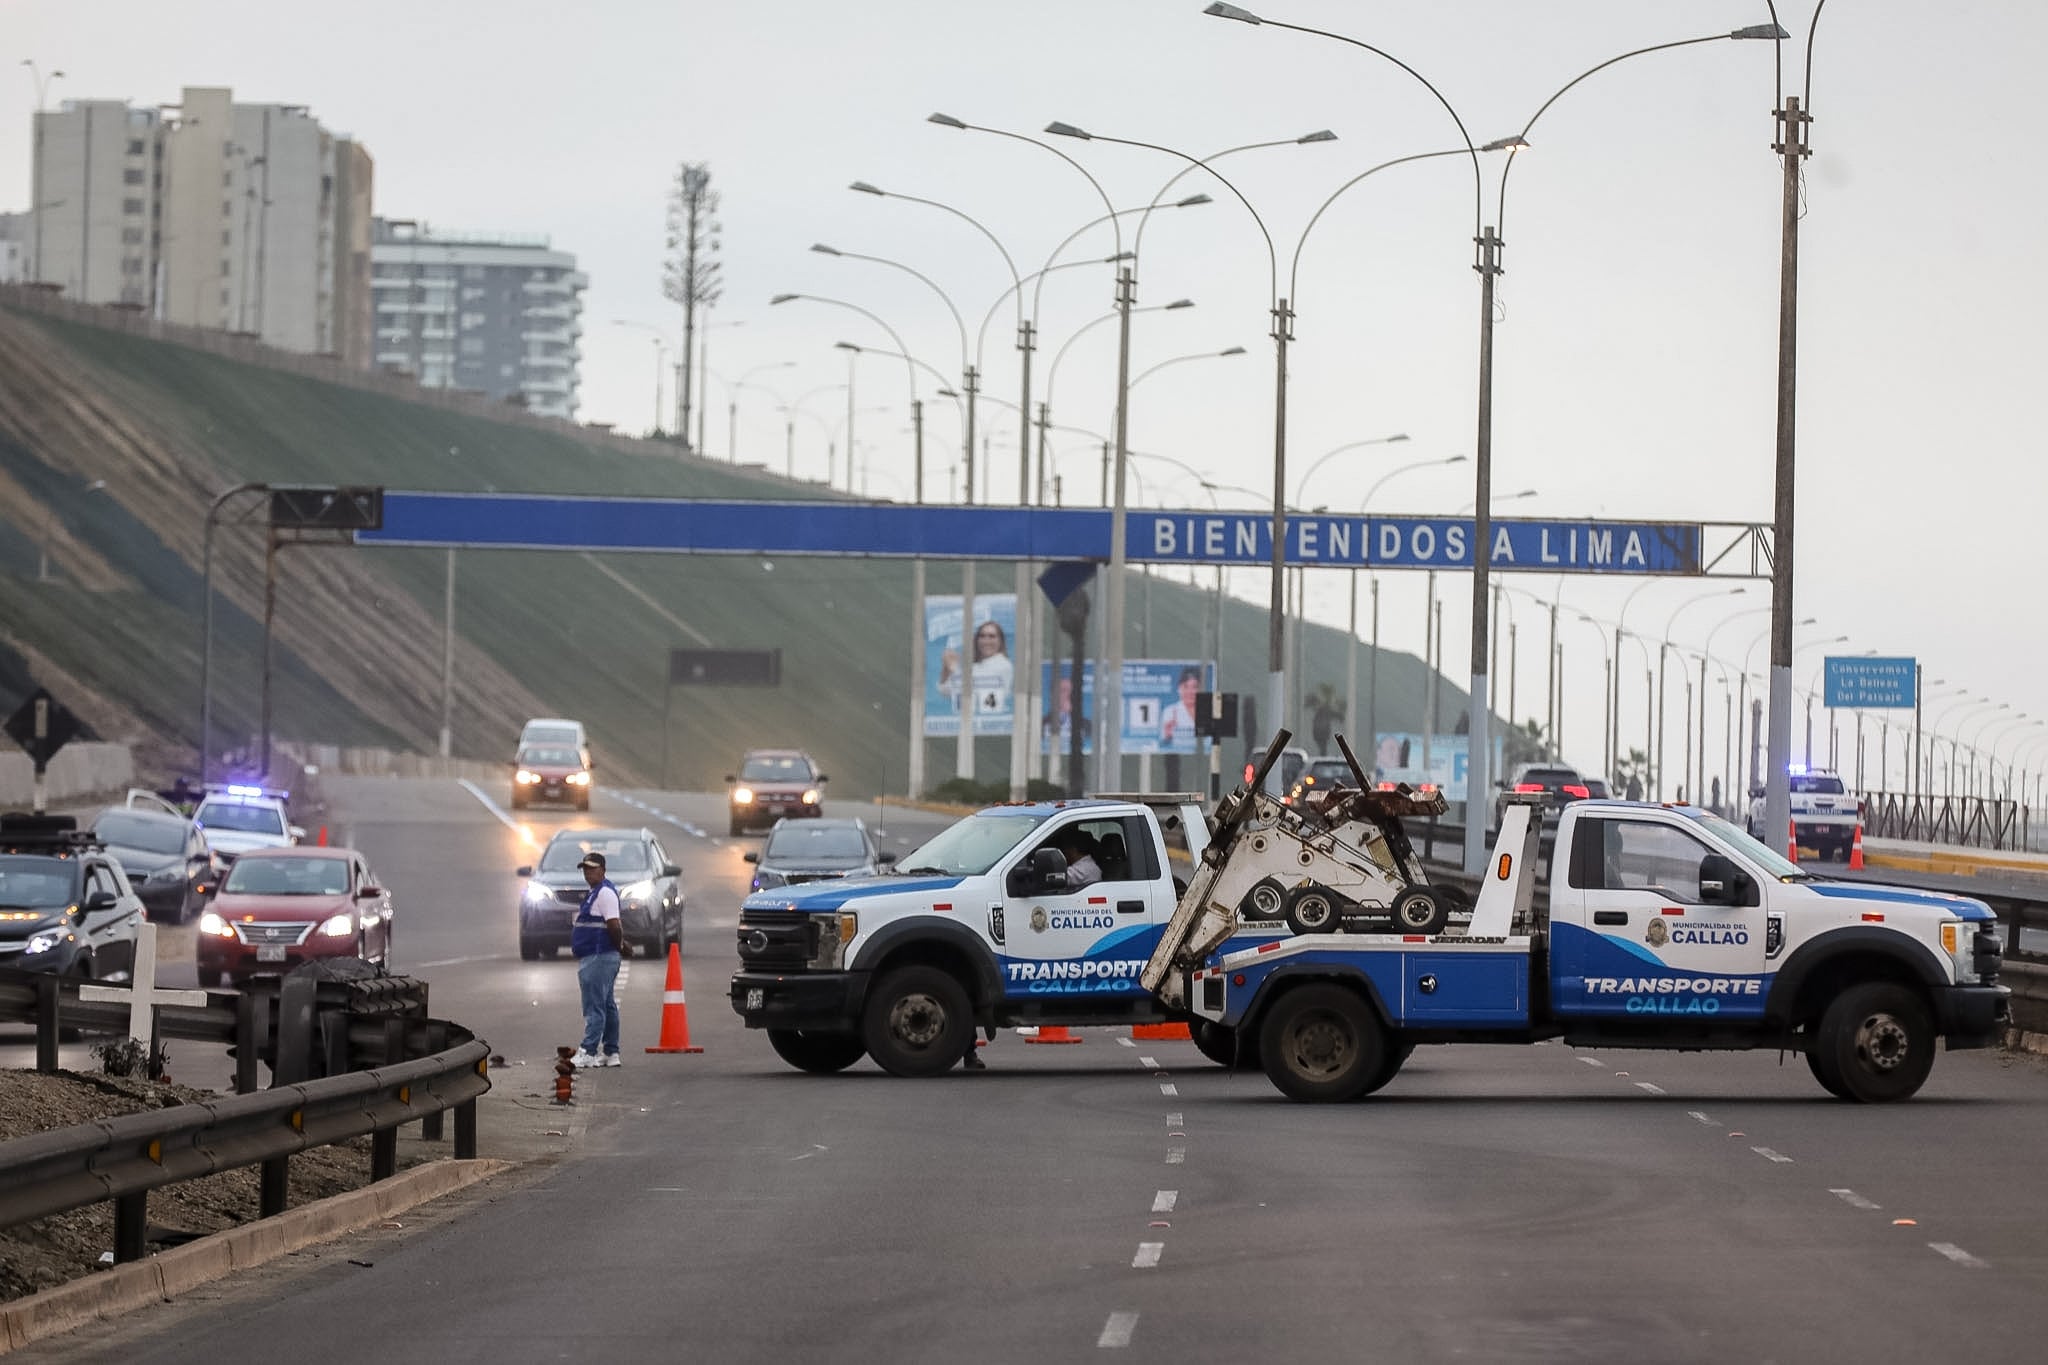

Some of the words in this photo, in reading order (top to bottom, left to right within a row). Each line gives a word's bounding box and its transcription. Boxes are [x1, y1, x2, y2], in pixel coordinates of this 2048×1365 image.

[1493, 528, 1516, 562] A
[1543, 528, 1648, 567] LIMA
[984, 692, 997, 708] 4
[1139, 704, 1148, 723] 1
[1051, 908, 1099, 916] MUNICIPALIDAD
[1051, 916, 1114, 929] CALLAO
[1672, 922, 1731, 930] MUNICIPALIDAD
[1672, 930, 1749, 945] CALLAO
[1007, 960, 1149, 981] TRANSPORT
[1028, 979, 1131, 993] CALLAO
[1584, 977, 1762, 995] TRANSPORTE
[1625, 996, 1720, 1014] CALLAO
